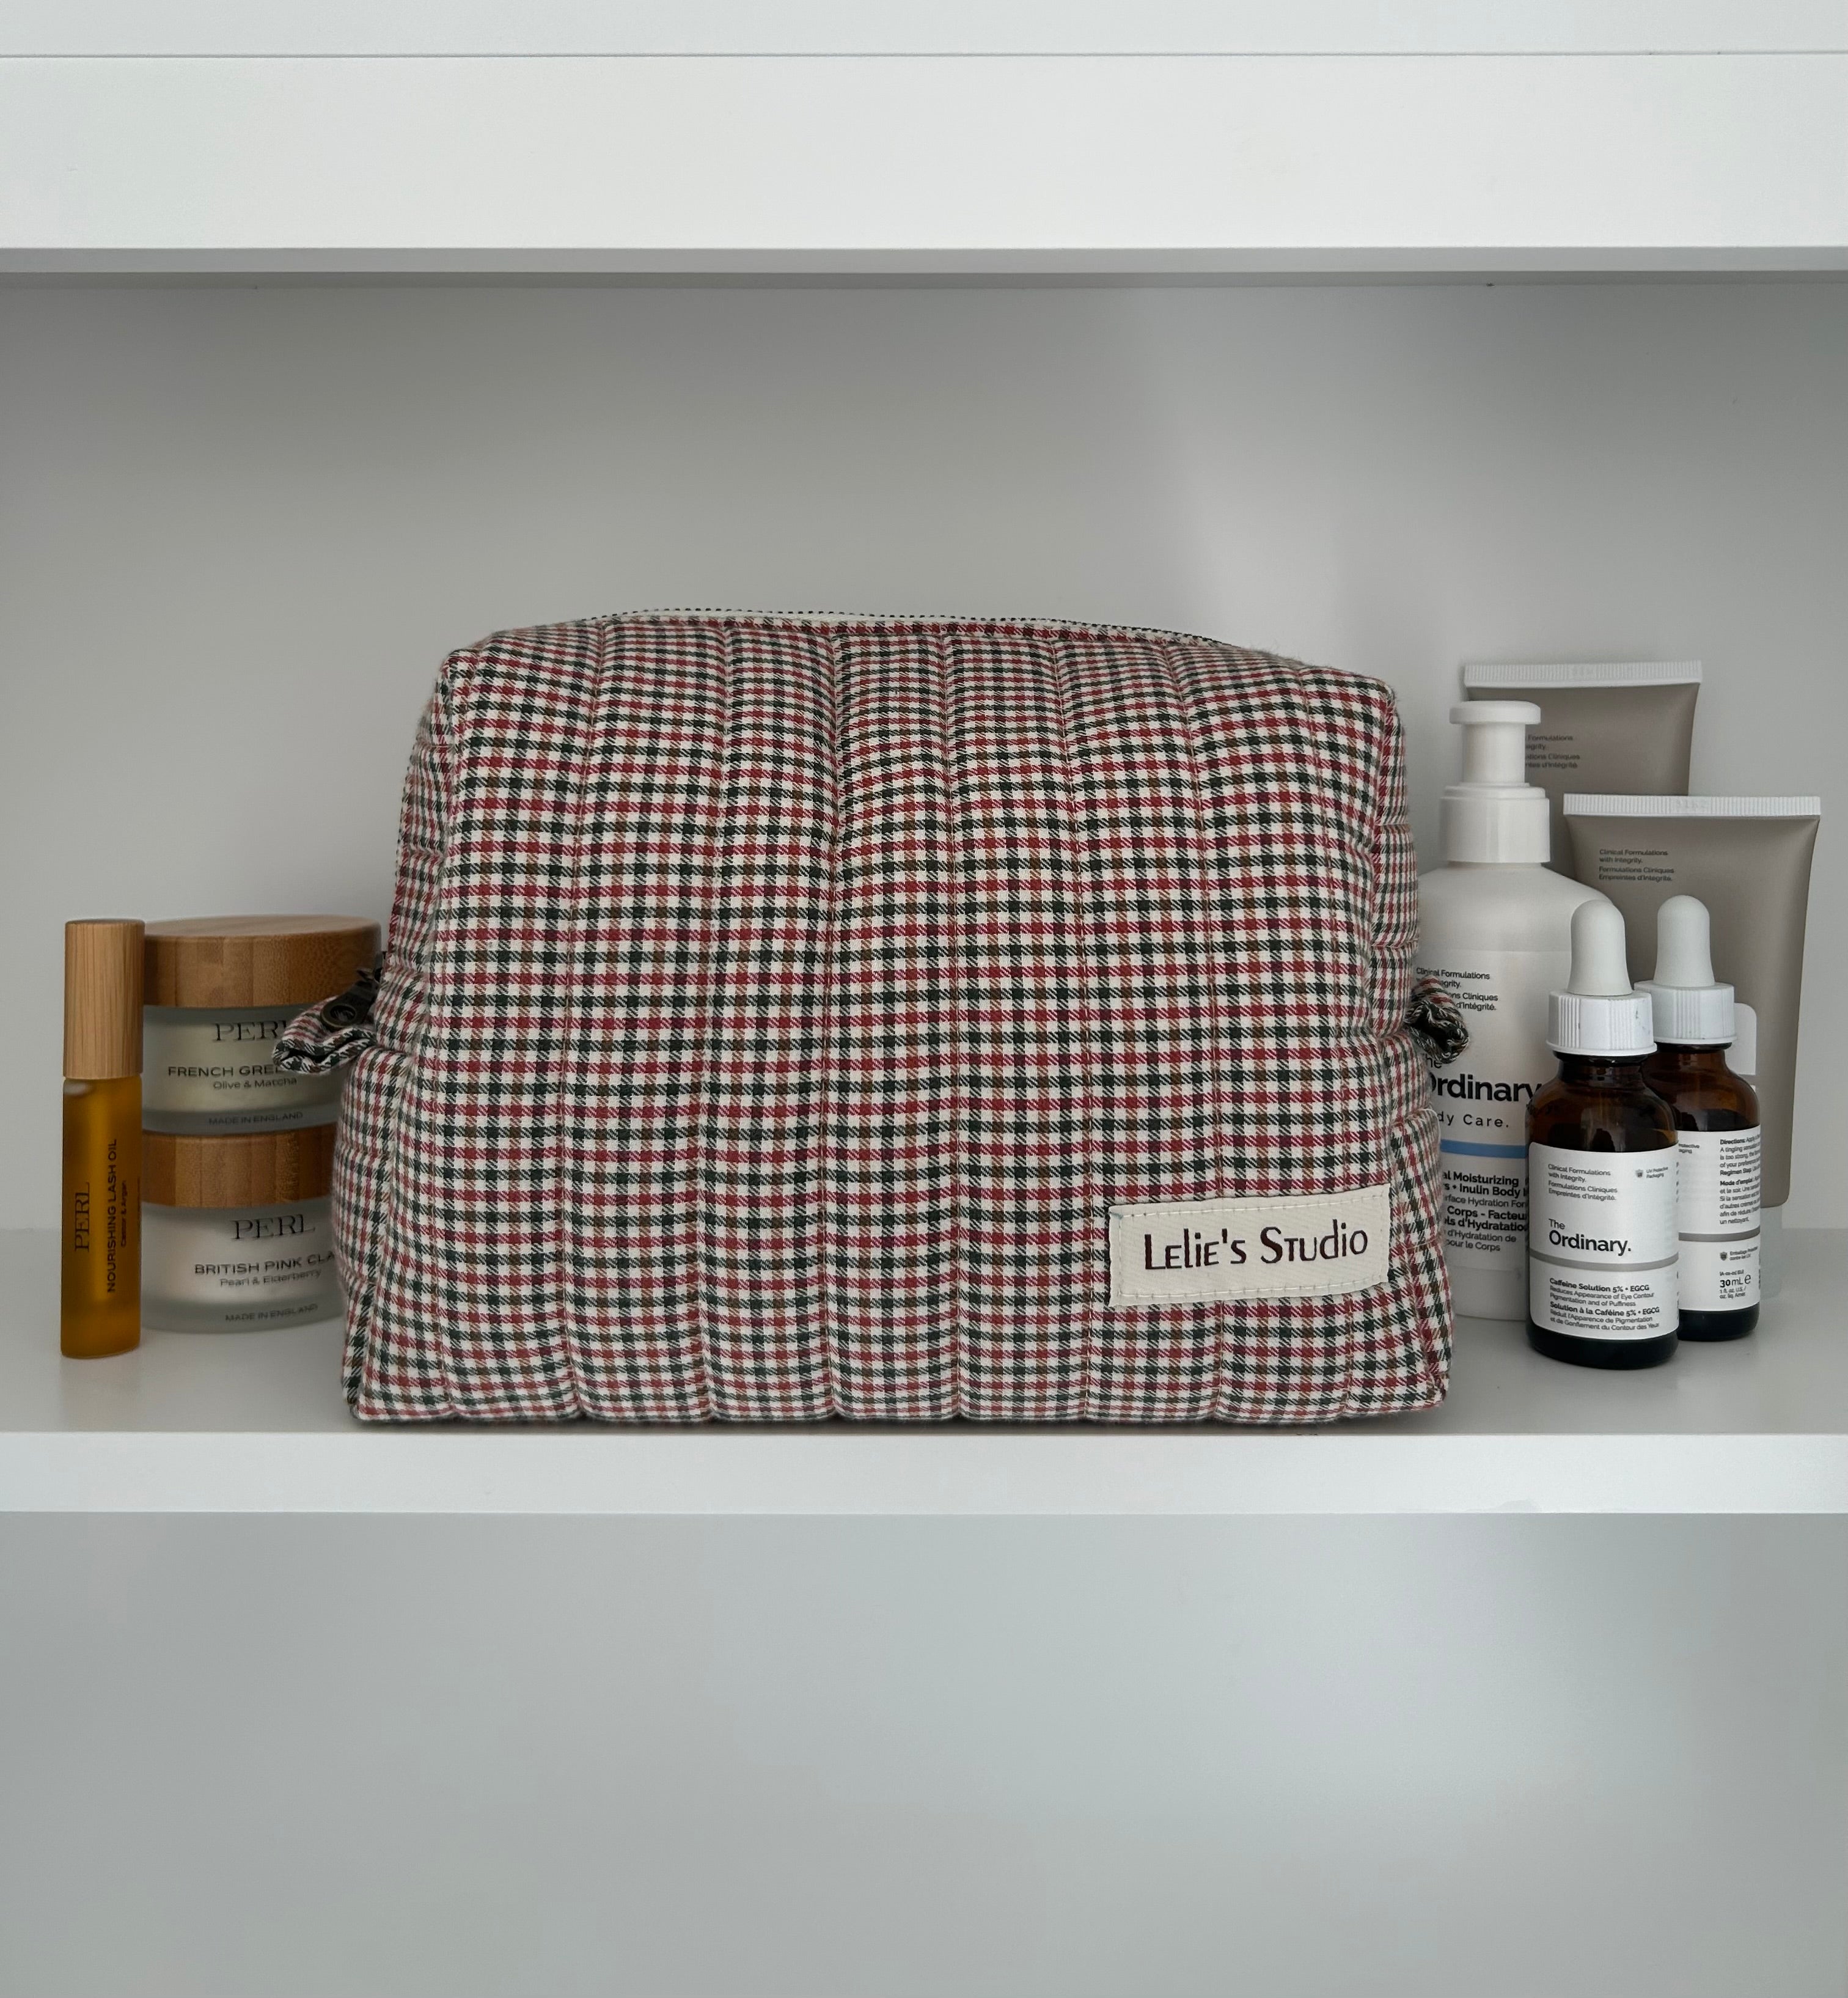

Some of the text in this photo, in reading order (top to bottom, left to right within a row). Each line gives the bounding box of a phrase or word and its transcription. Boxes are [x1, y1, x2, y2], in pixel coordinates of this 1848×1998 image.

[1441, 970, 1490, 980] Formulations
[1462, 992, 1498, 1002] Cliniques
[1423, 1053, 1442, 1068] he
[168, 1066, 233, 1077] FRENCH
[213, 1081, 240, 1090] Olive
[255, 1077, 297, 1088] Matcha
[209, 1116, 239, 1125] MADE
[254, 1111, 303, 1123] ENGLAND
[1437, 1111, 1509, 1128] dy Care.
[1548, 1164, 1611, 1175] Clinical Formulations
[1453, 1171, 1519, 1188] Moisturizing
[1560, 1173, 1586, 1183] Integrity.
[1459, 1183, 1489, 1195] Inulin
[1492, 1186, 1520, 1199] Body
[1549, 1180, 1586, 1191] Formulations
[1549, 1188, 1580, 1199] Empreintes
[1445, 1194, 1465, 1204] rface
[1468, 1197, 1509, 1207] Hydration
[75, 1182, 90, 1252] PERL
[107, 1139, 117, 1293] NOURISHING LASH OIL
[1447, 1205, 1478, 1221] Corps
[231, 1214, 315, 1240] PERL
[1549, 1218, 1565, 1230] The
[1448, 1229, 1503, 1241] d'Hydratation
[1145, 1219, 1368, 1269] Lelie's Studio
[1475, 1242, 1500, 1252] Corps
[1549, 1230, 1631, 1257] Ordinary.
[194, 1251, 335, 1274] BRITISH PINK CLA
[221, 1277, 249, 1287] Pearl
[1550, 1277, 1577, 1288] Caffeine
[1579, 1284, 1611, 1292] Solution
[1574, 1291, 1612, 1299] Appearance
[226, 1313, 255, 1321] MADE
[270, 1303, 318, 1318] ENGLAND
[1550, 1301, 1577, 1313] Solution
